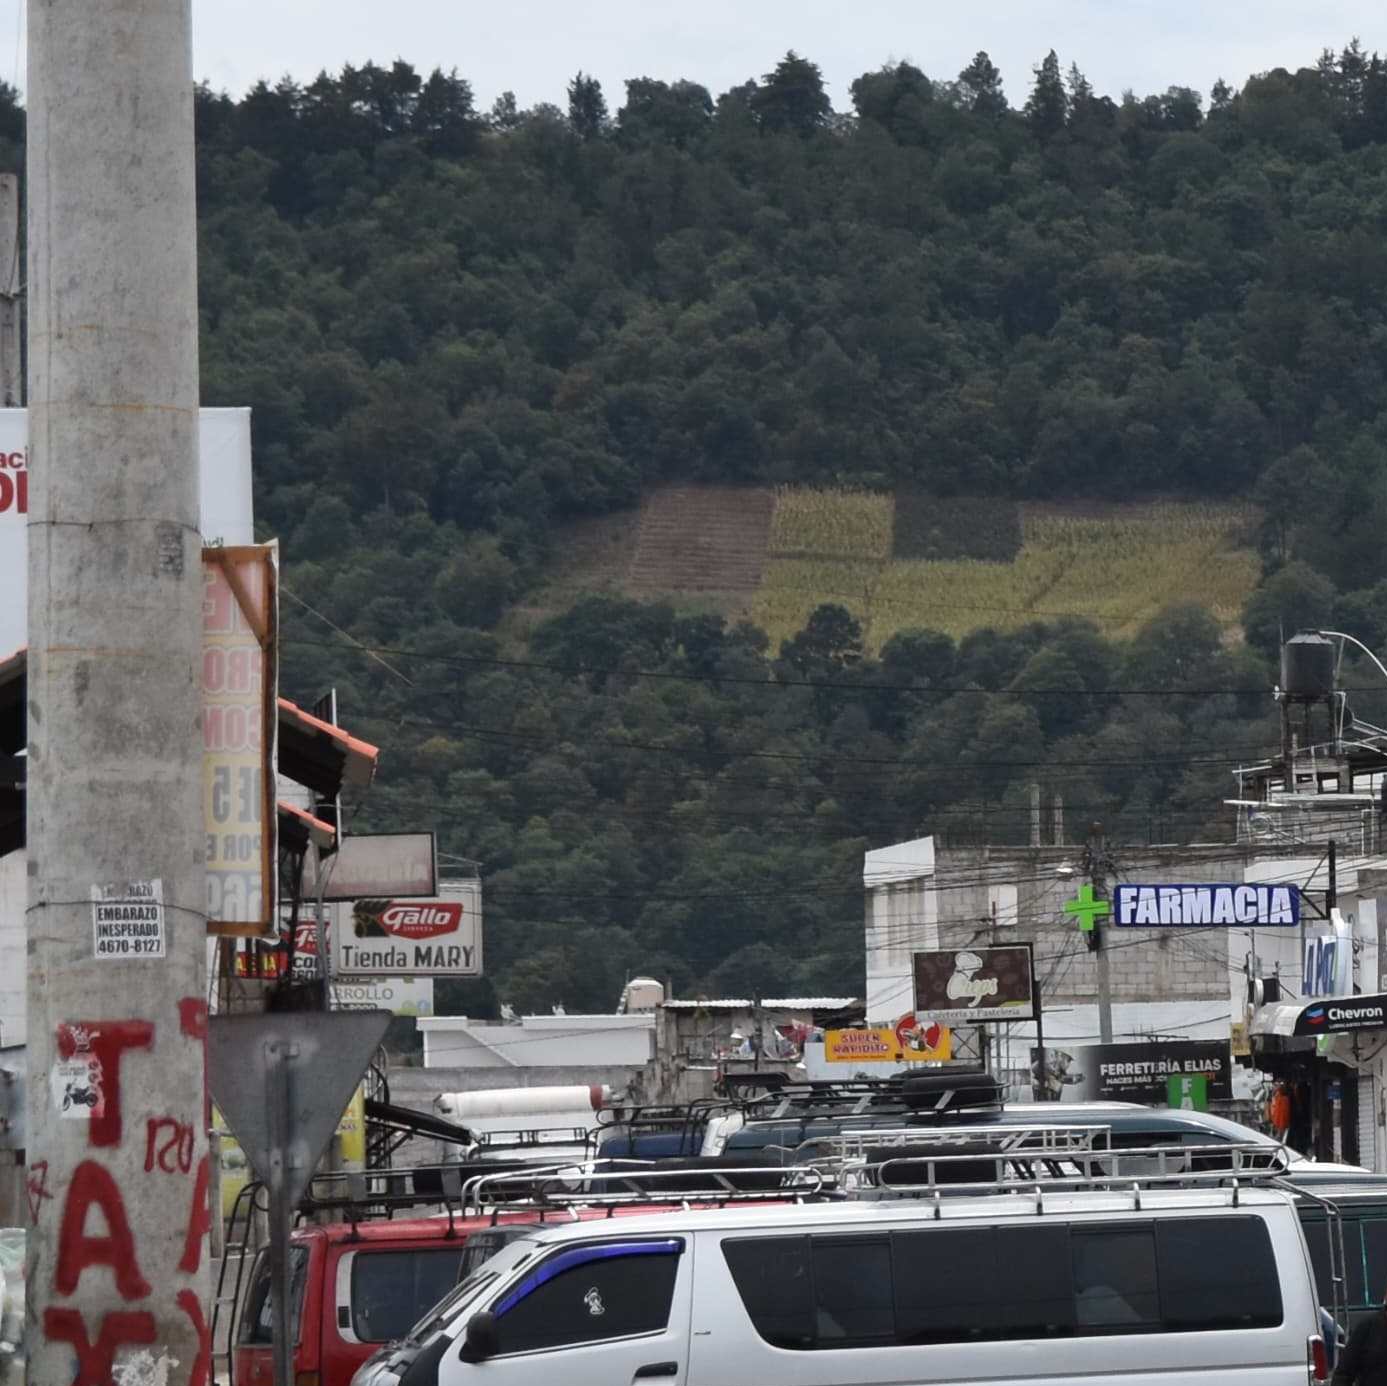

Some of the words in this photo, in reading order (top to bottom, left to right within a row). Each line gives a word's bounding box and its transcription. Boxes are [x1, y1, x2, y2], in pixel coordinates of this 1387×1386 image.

[1119, 886, 1294, 924] FARMACIA
[98, 906, 158, 921] EMBARAZO
[382, 906, 452, 931] Gallo
[99, 923, 159, 938] INESPERADO
[99, 939, 161, 953] 4670-8127
[341, 945, 407, 968] Tienda
[414, 945, 475, 968] MARY
[1328, 1006, 1383, 1020] Chevron
[1184, 1059, 1222, 1072] ELIAS
